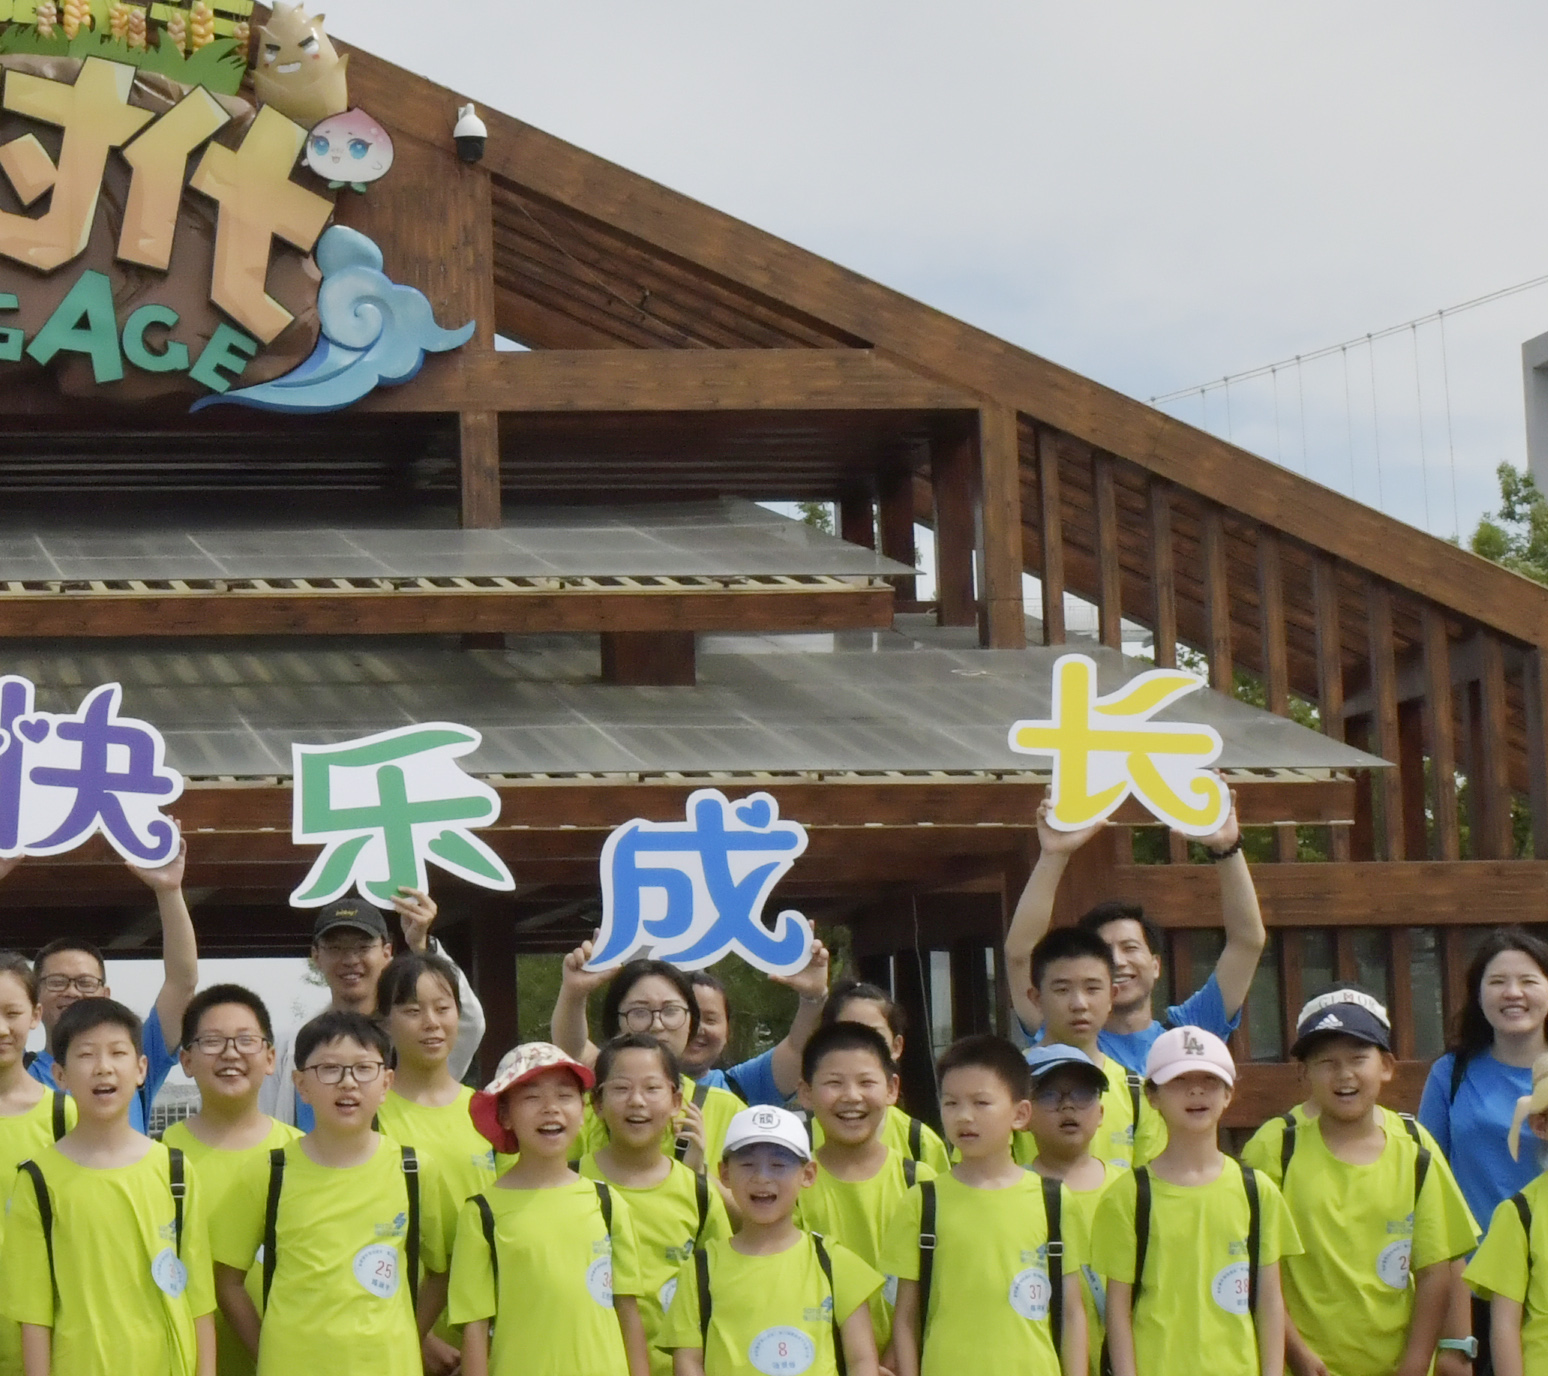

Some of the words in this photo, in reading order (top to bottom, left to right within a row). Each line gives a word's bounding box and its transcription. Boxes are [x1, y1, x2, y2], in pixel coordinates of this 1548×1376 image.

[26, 269, 265, 395] AGE
[1012, 656, 1226, 830] 长
[292, 724, 511, 906] 乐
[586, 791, 812, 973] 成
[1183, 1031, 1204, 1055] LA
[375, 1261, 393, 1279] 25
[1029, 1285, 1042, 1300] 37
[778, 1343, 788, 1358] 8
